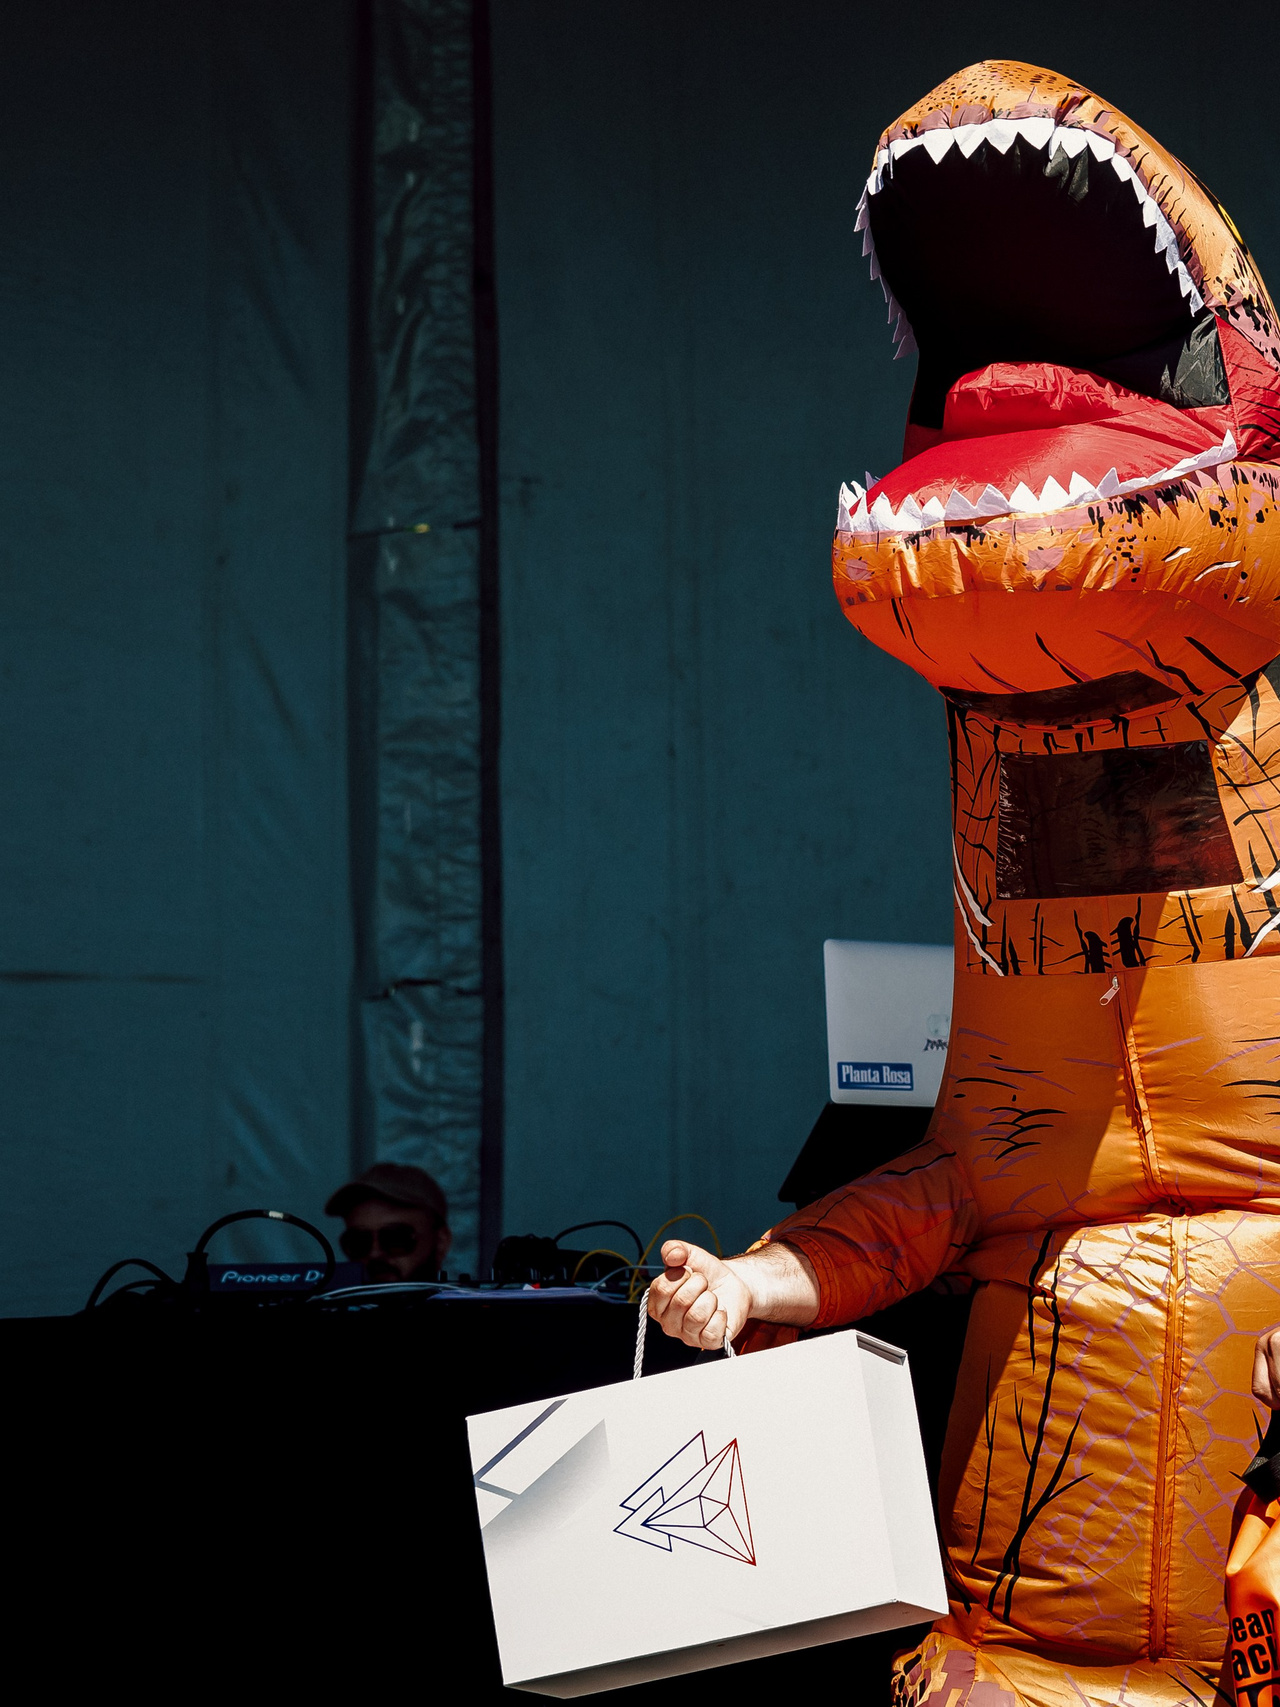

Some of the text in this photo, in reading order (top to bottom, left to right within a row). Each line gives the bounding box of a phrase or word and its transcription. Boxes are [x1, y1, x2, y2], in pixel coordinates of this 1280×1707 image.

[841, 1064, 911, 1084] Planta Rosa
[221, 1269, 301, 1285] Pioneer
[1228, 1608, 1274, 1645] ean
